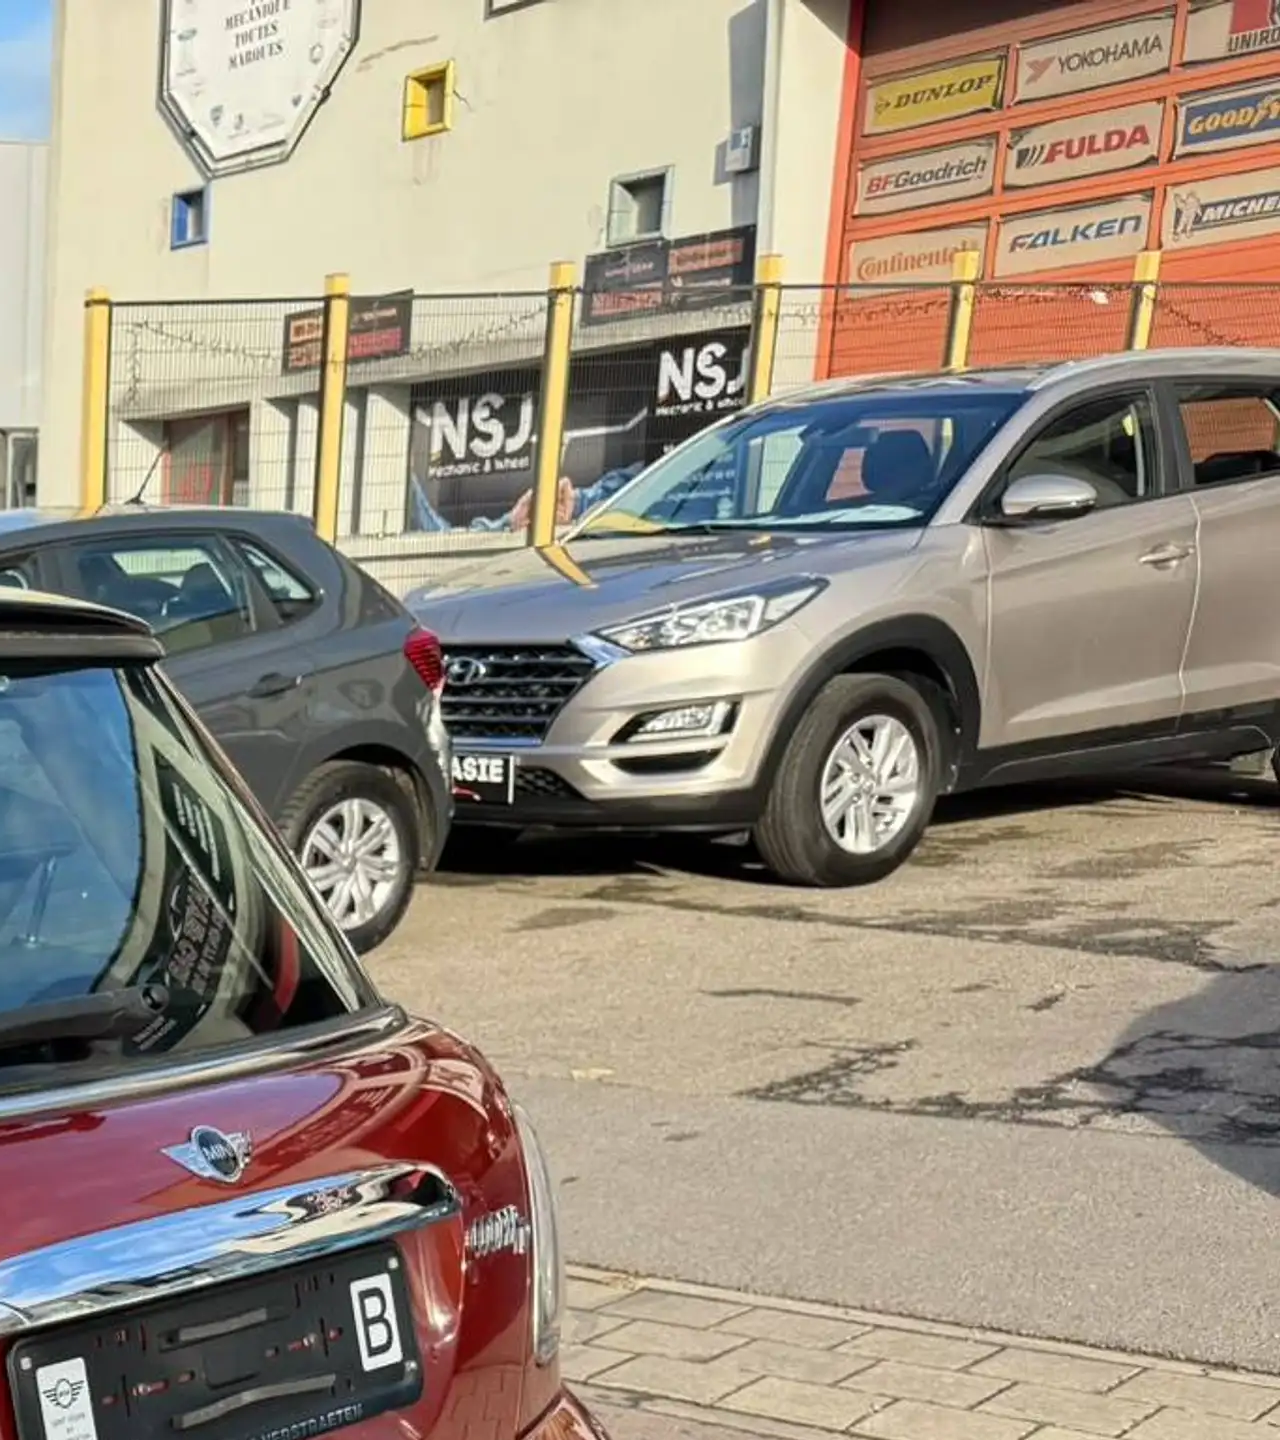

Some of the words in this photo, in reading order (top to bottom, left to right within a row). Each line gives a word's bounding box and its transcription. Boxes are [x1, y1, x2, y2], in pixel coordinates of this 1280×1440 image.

[227, 40, 285, 71] MARQUES
[1057, 33, 1164, 74] YOKOHAMA
[893, 74, 996, 109] DUNLOP
[1043, 124, 1150, 165] FULDA
[866, 155, 988, 194] BFGoodrich
[1201, 194, 1280, 223] MICHE
[357, 1286, 395, 1359] B
